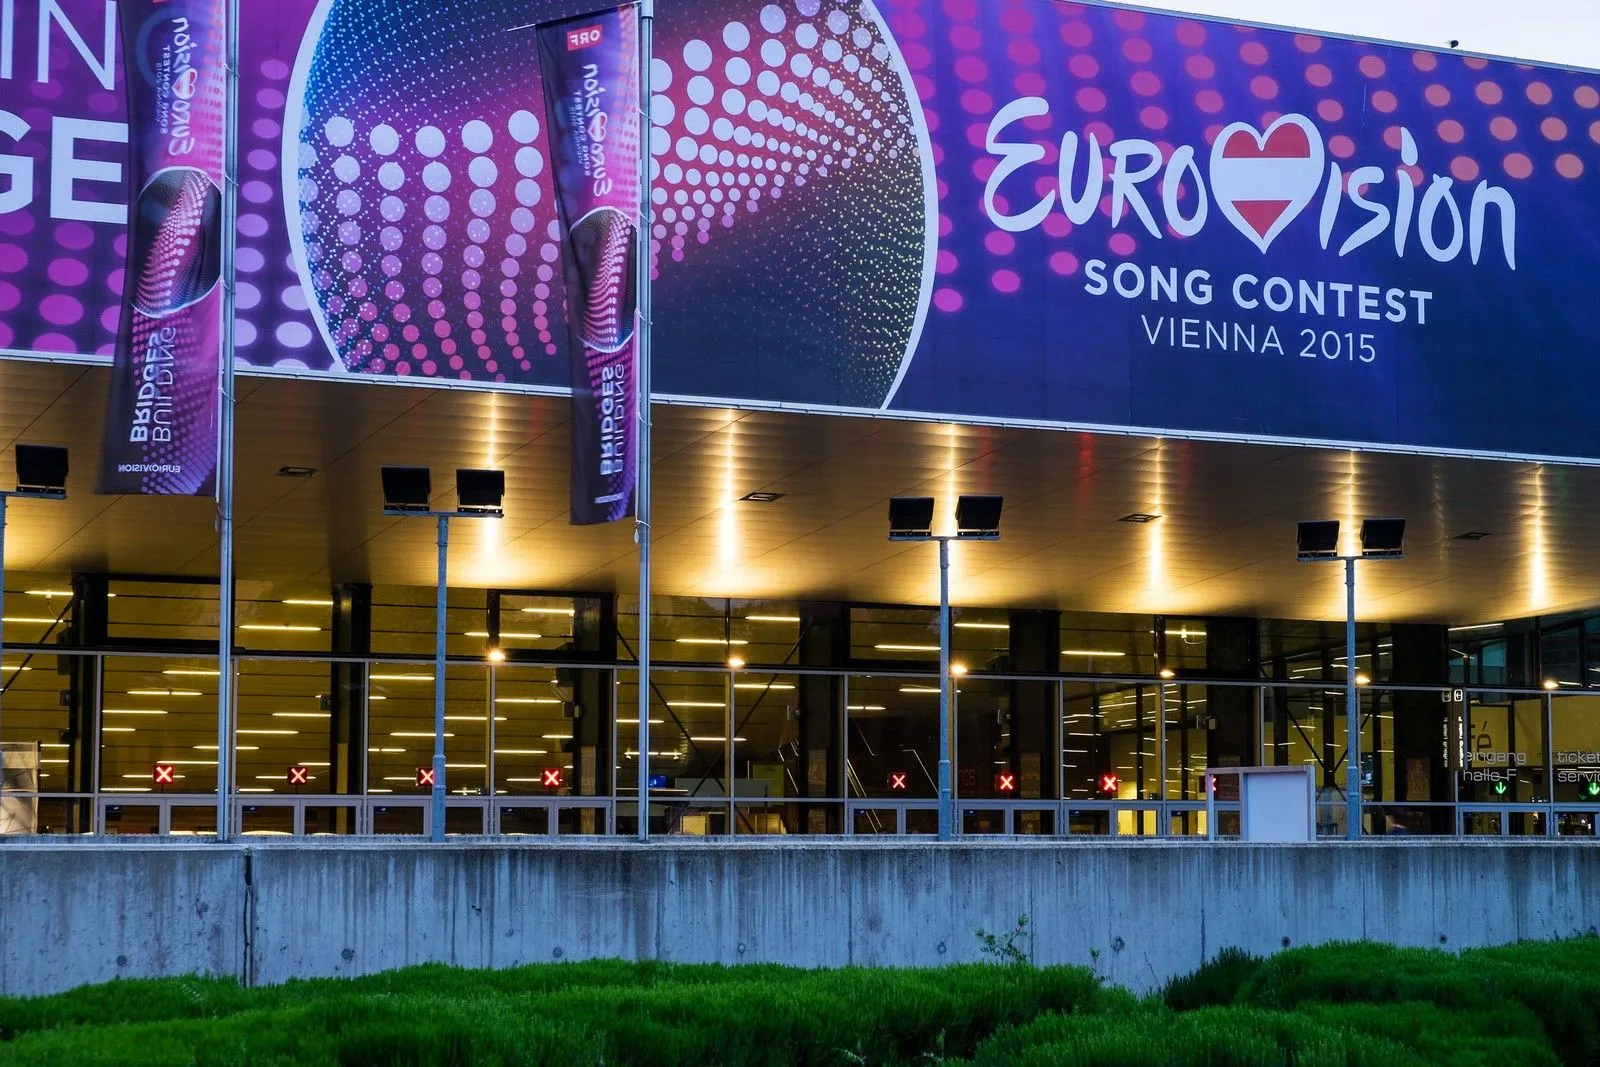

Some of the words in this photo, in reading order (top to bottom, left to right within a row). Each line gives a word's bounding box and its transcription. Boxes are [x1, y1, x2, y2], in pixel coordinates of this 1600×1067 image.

[1083, 258, 1213, 305] SONG
[1232, 272, 1433, 325] CONTEST
[1141, 314, 1284, 356] VIENNA
[1299, 328, 1376, 363] 2015
[1466, 750, 1527, 765] eingang
[1463, 768, 1500, 782] halle
[1506, 768, 1517, 782] F
[1557, 770, 1600, 783] servi
